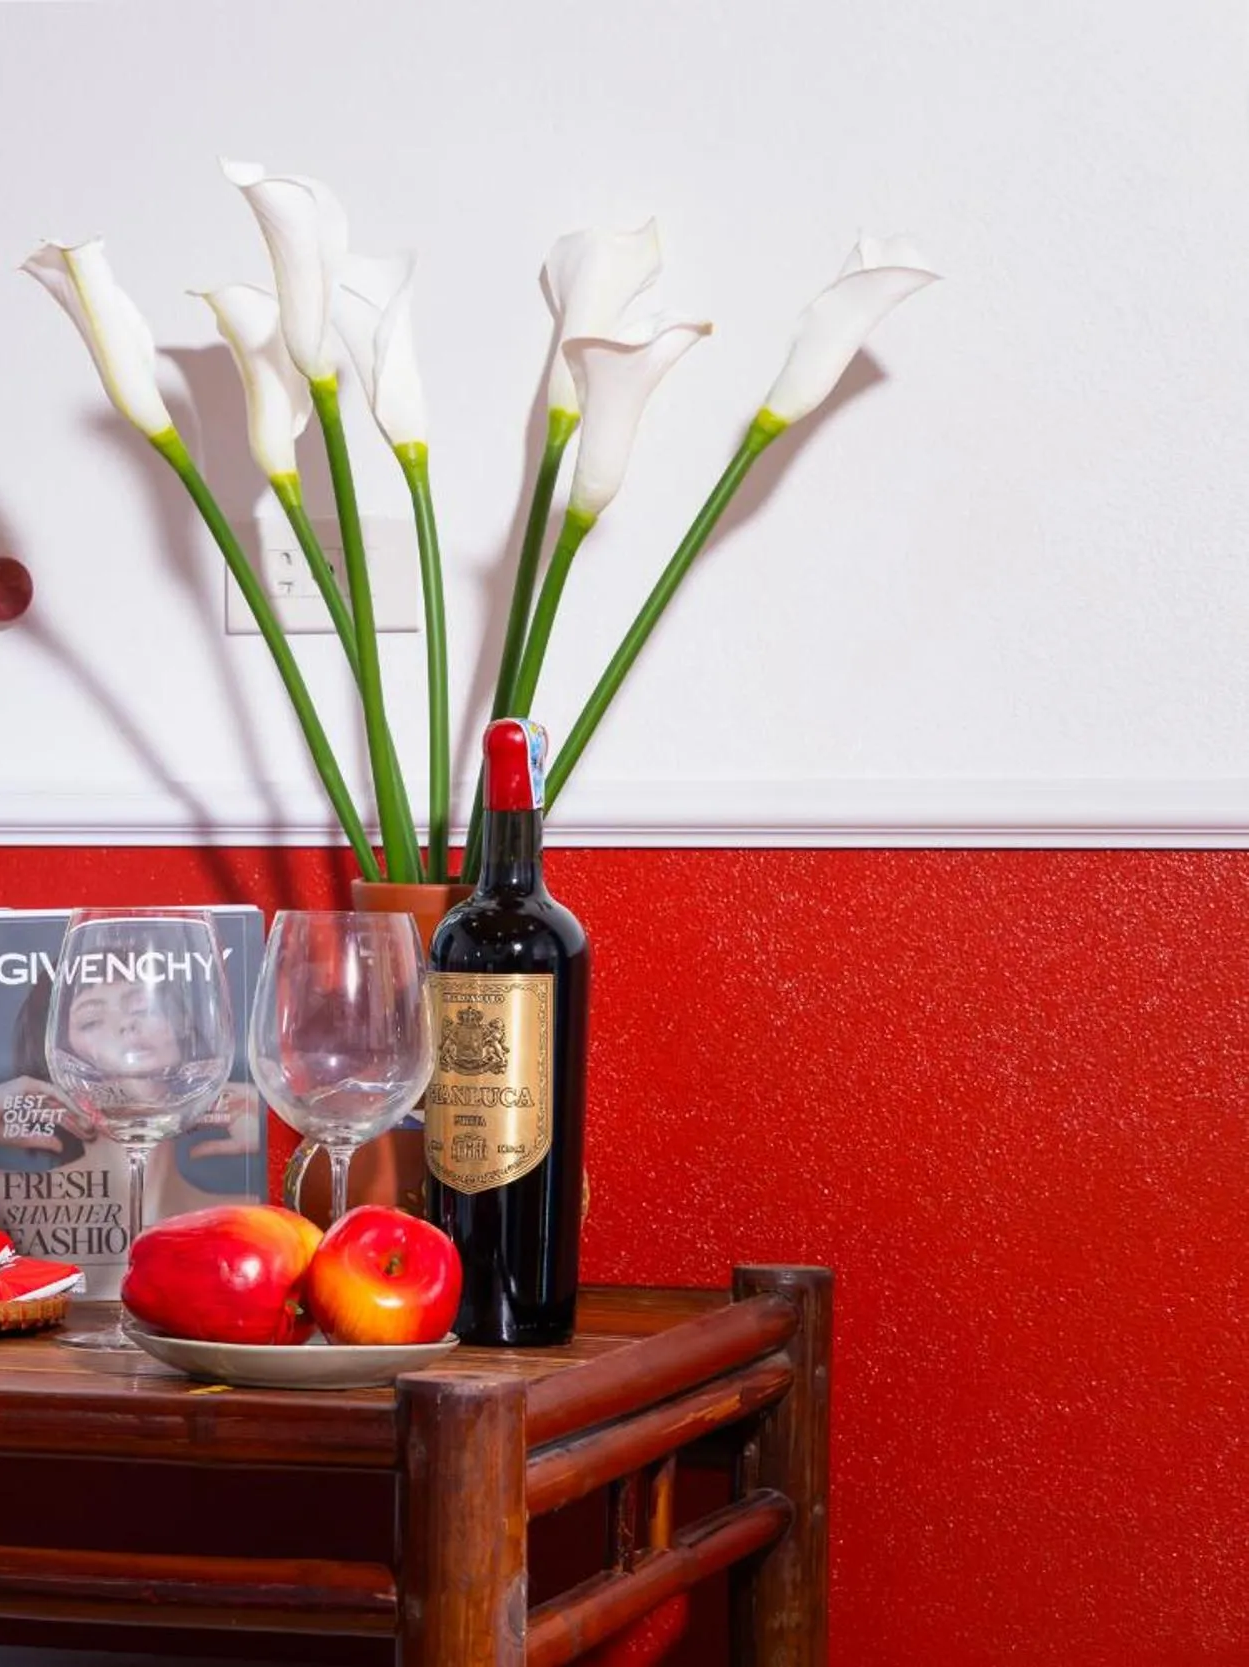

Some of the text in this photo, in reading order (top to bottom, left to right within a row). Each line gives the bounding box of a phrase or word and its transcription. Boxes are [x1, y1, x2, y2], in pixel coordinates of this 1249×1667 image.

[3, 1094, 47, 1110] BEST
[3, 1108, 68, 1123] OUTFIT
[3, 1122, 55, 1139] IDEAS
[3, 1170, 110, 1200] FRESH
[3, 1203, 124, 1227] SUMMER
[7, 1226, 129, 1255] FASHIO
